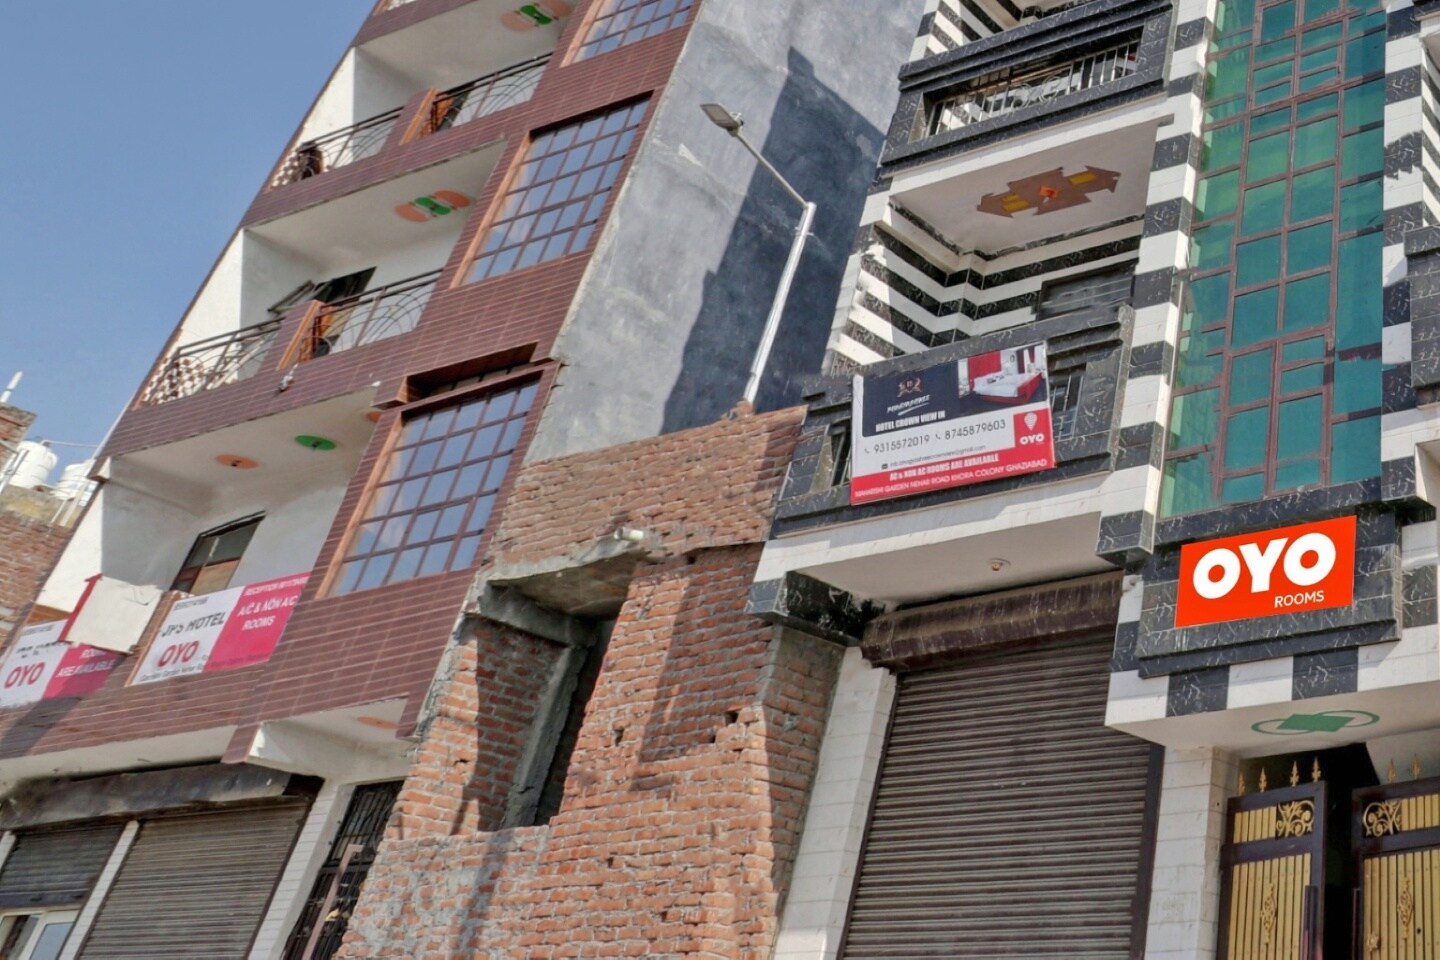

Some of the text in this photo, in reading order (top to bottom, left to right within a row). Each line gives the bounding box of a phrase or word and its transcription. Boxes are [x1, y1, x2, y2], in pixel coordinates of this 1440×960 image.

[875, 409, 946, 433] HOTEL CROWN VIEW IN
[873, 419, 1006, 453] 9315572019 8745879603
[1019, 433, 1045, 445] OYO
[974, 464, 1005, 479] COLONY
[1193, 532, 1336, 600] OYO
[1274, 590, 1325, 609] ROOMS
[184, 611, 226, 633] HOTEL
[241, 614, 277, 632] ROOMS
[157, 639, 200, 668] OYO
[3, 660, 47, 690] OYO
